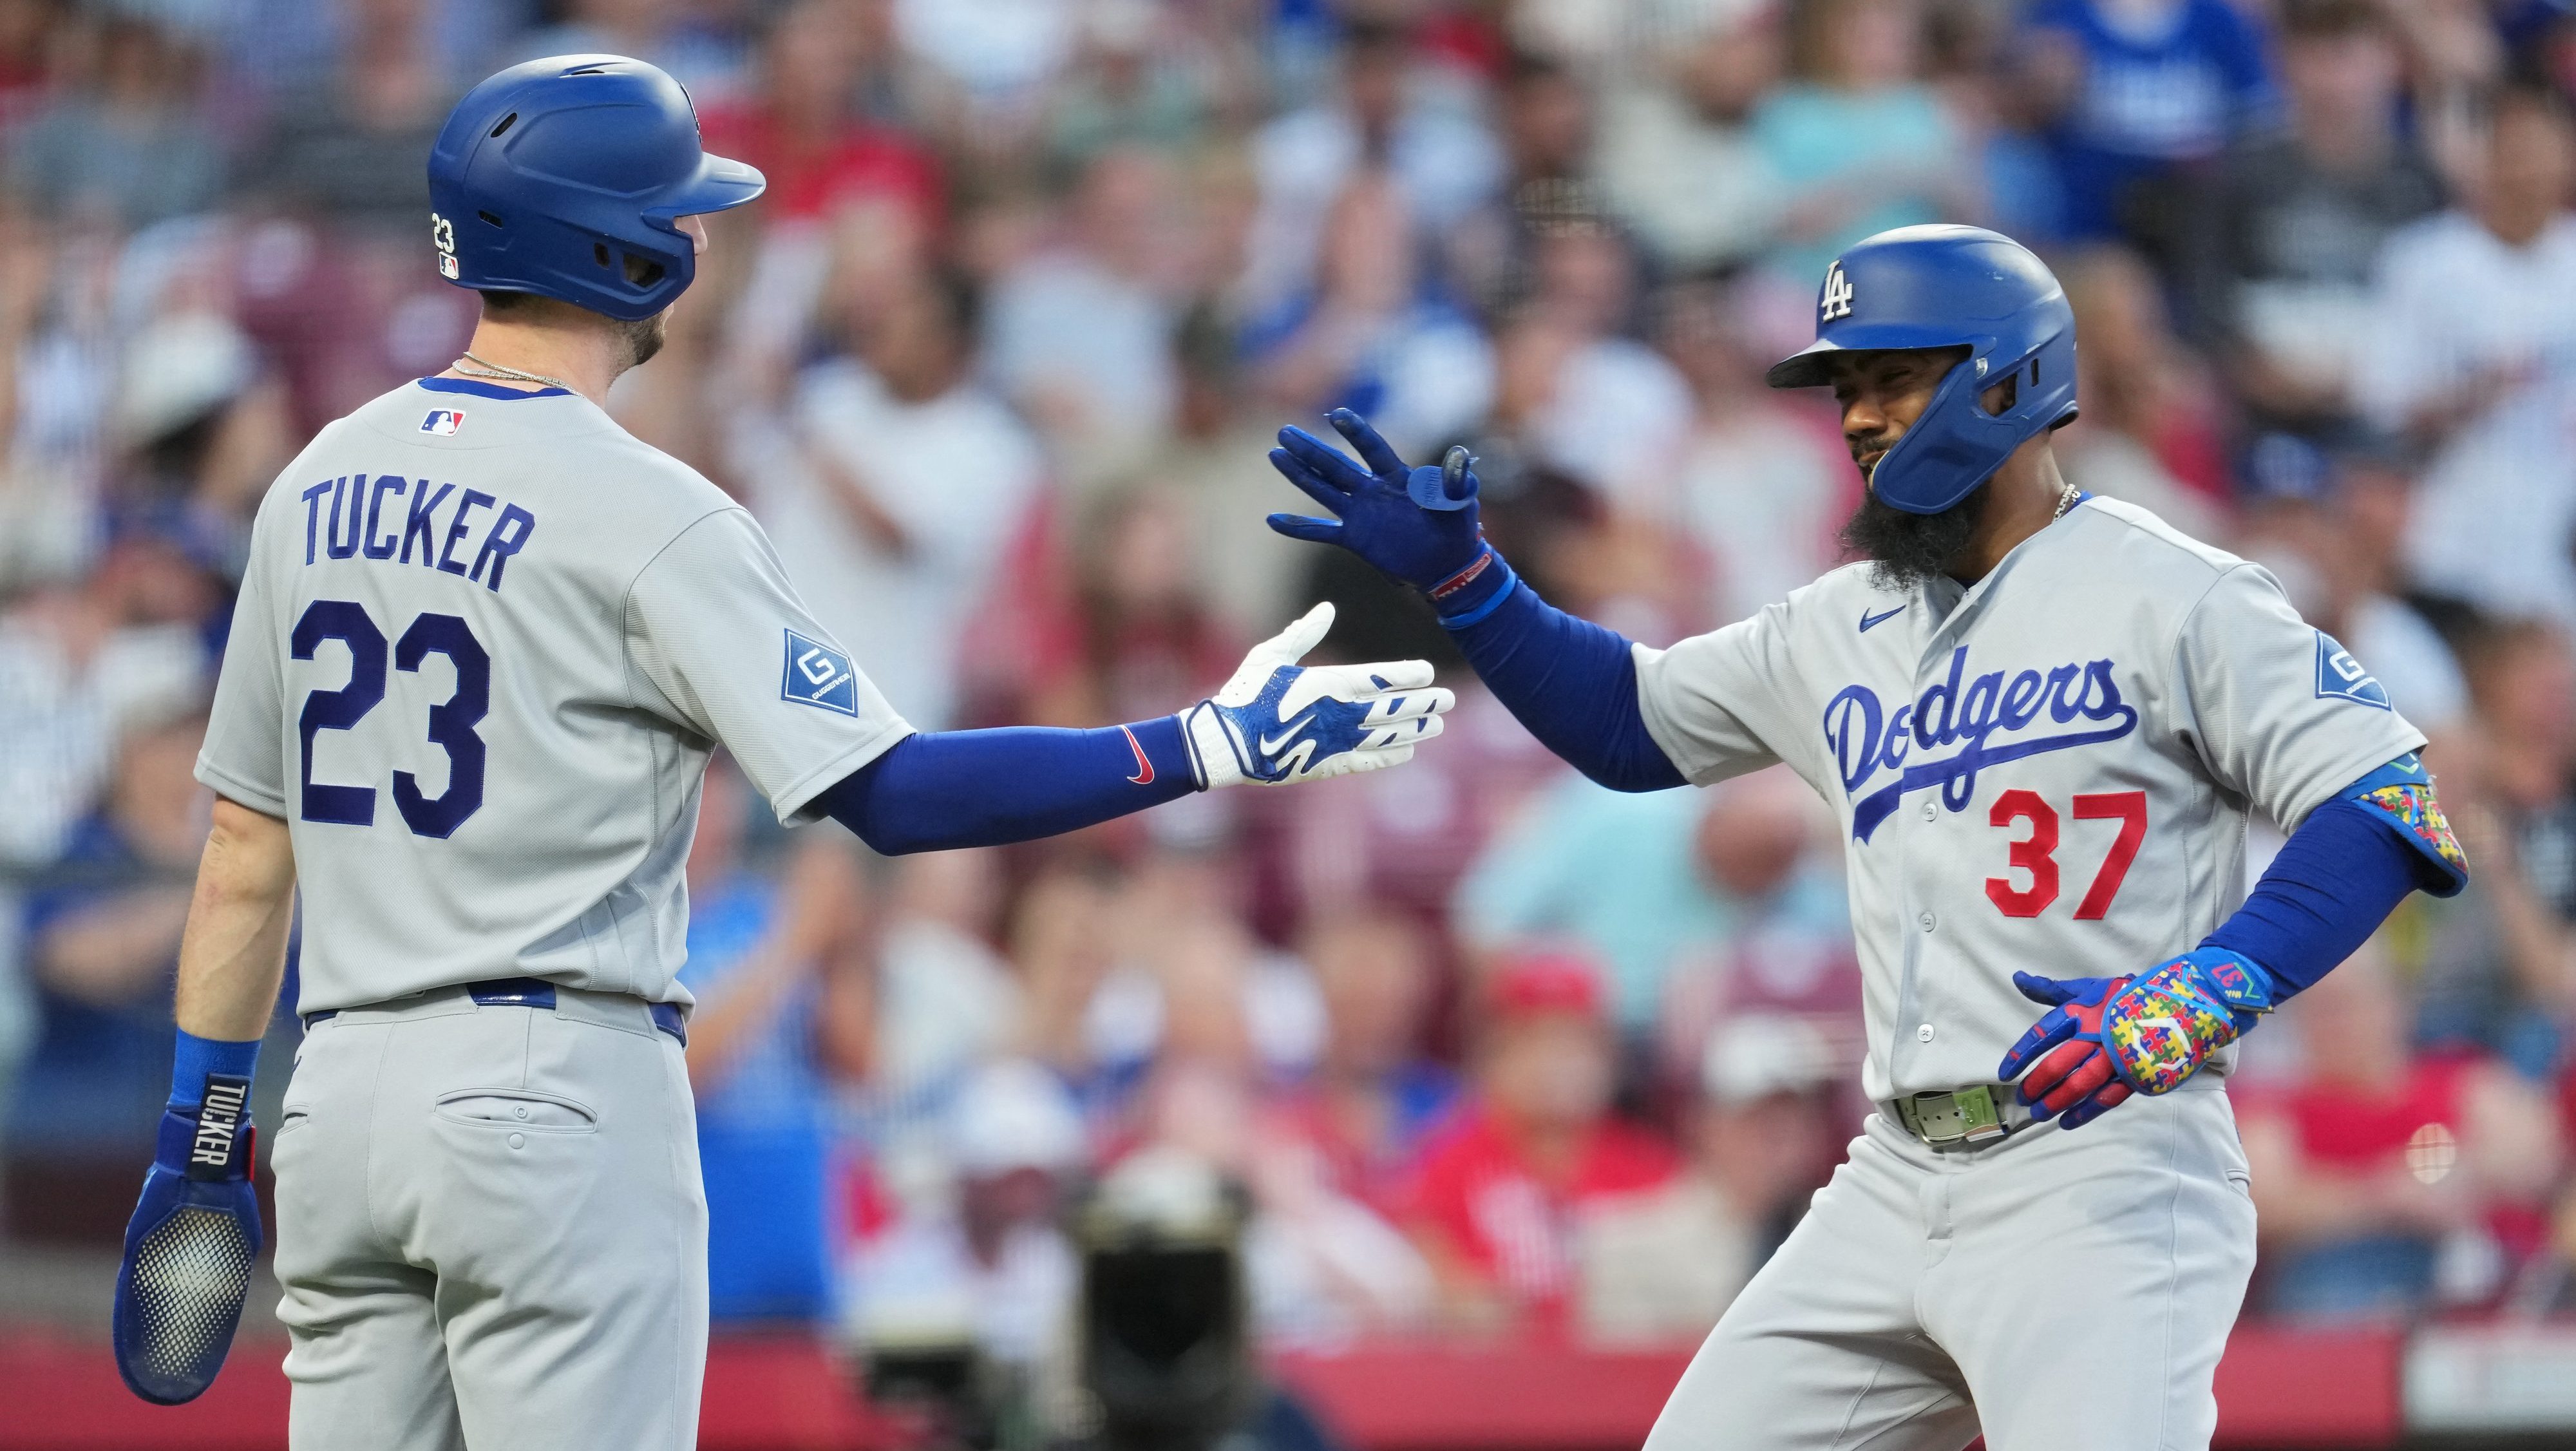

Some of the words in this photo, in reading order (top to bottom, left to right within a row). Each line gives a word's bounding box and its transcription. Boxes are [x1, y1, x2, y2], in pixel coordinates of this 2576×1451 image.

[431, 213, 455, 254] 23
[1821, 260, 1853, 322] LA
[301, 473, 535, 593] TUCKER
[797, 647, 836, 685] G
[291, 600, 491, 840] 23
[1824, 645, 2133, 813] Dodgers
[1985, 789, 2148, 920] 37
[2211, 963, 2244, 988] 37
[192, 1085, 246, 1166] TUCKER
